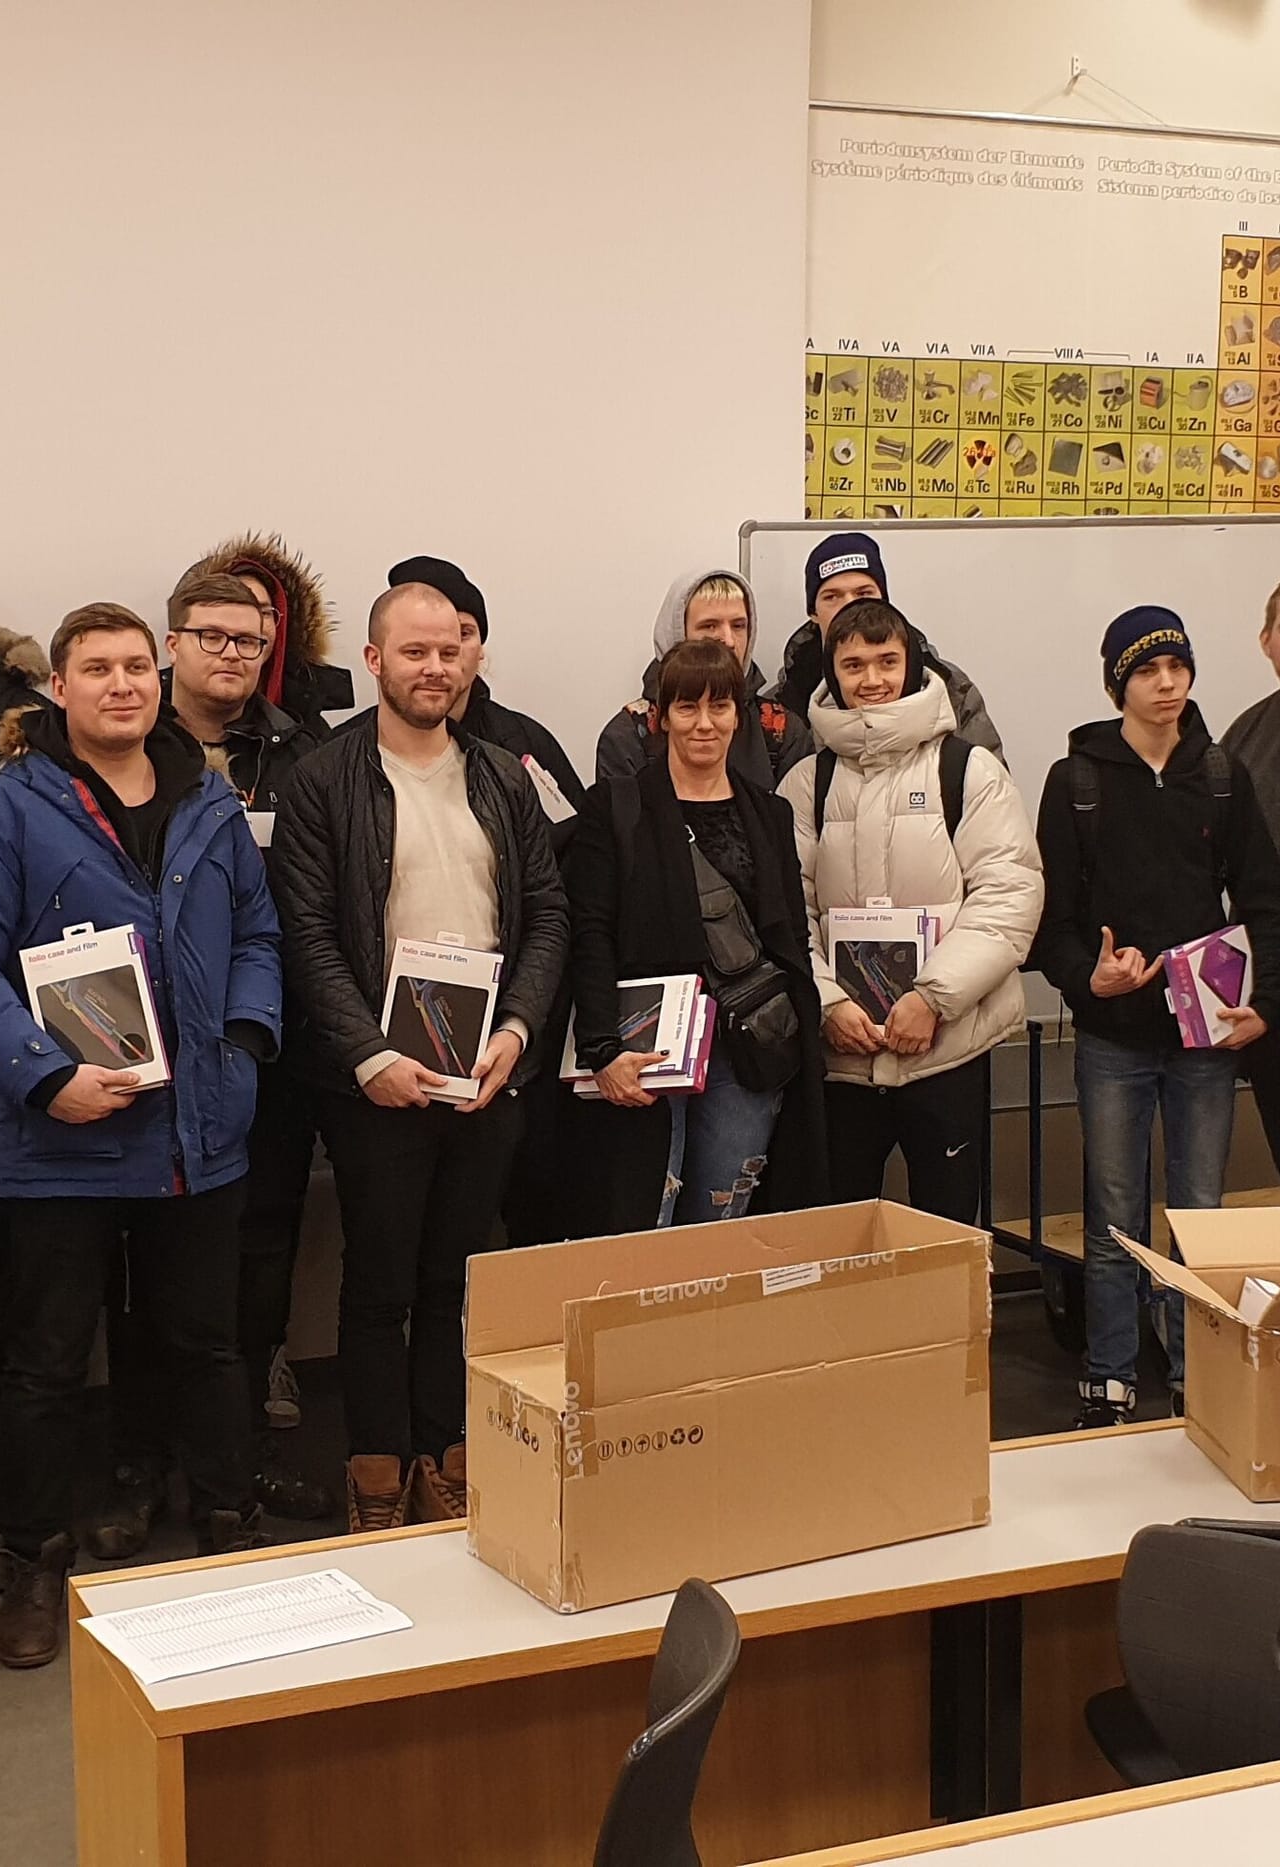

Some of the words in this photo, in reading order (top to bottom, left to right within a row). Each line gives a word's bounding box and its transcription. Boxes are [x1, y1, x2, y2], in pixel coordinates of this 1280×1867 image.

[840, 138, 974, 163] Periodensystem
[976, 149, 1008, 165] der
[1010, 150, 1085, 170] Elemente
[811, 159, 883, 179] Système
[885, 163, 975, 187] périodique
[978, 170, 1008, 187] des
[1010, 170, 1084, 192] éléments
[1098, 157, 1163, 176] Periodic
[1165, 162, 1222, 180] System
[1224, 167, 1243, 181] of
[1243, 168, 1271, 184] the
[1097, 179, 1159, 197] Sistema
[1236, 188, 1257, 204] de
[1258, 190, 1280, 206] los
[1238, 221, 1249, 231] III
[1239, 285, 1248, 298] B
[1237, 352, 1251, 366] Al
[843, 407, 857, 422] Ti
[886, 408, 898, 423] V
[932, 409, 950, 424] Cr
[978, 411, 1000, 425] Mn
[1018, 413, 1035, 427] Fe
[1063, 414, 1083, 428] Co
[1107, 415, 1123, 429] Ni
[1148, 416, 1166, 430] Cu
[1188, 417, 1207, 431] Zn
[1233, 418, 1252, 433] Ga
[839, 477, 854, 491] Zr
[886, 478, 907, 492] Nb
[932, 480, 955, 494] Mo
[975, 479, 991, 493] Tc
[1016, 480, 1035, 495] Ru
[1061, 481, 1080, 495] Rh
[1105, 482, 1123, 495] Pd
[1146, 483, 1164, 498] Ag
[1185, 483, 1205, 497] Cd
[1229, 484, 1243, 497] In
[910, 793, 925, 804] 66
[866, 913, 879, 922] and
[879, 913, 893, 922] film
[28, 953, 47, 963] folio
[47, 950, 65, 959] case
[66, 944, 82, 956] and
[82, 940, 98, 951] film
[402, 946, 419, 956] folio
[420, 949, 437, 959] case
[437, 951, 452, 962] and
[453, 952, 469, 964] film
[639, 1275, 729, 1307] Lenovo
[563, 1381, 585, 1482] Lenovo
